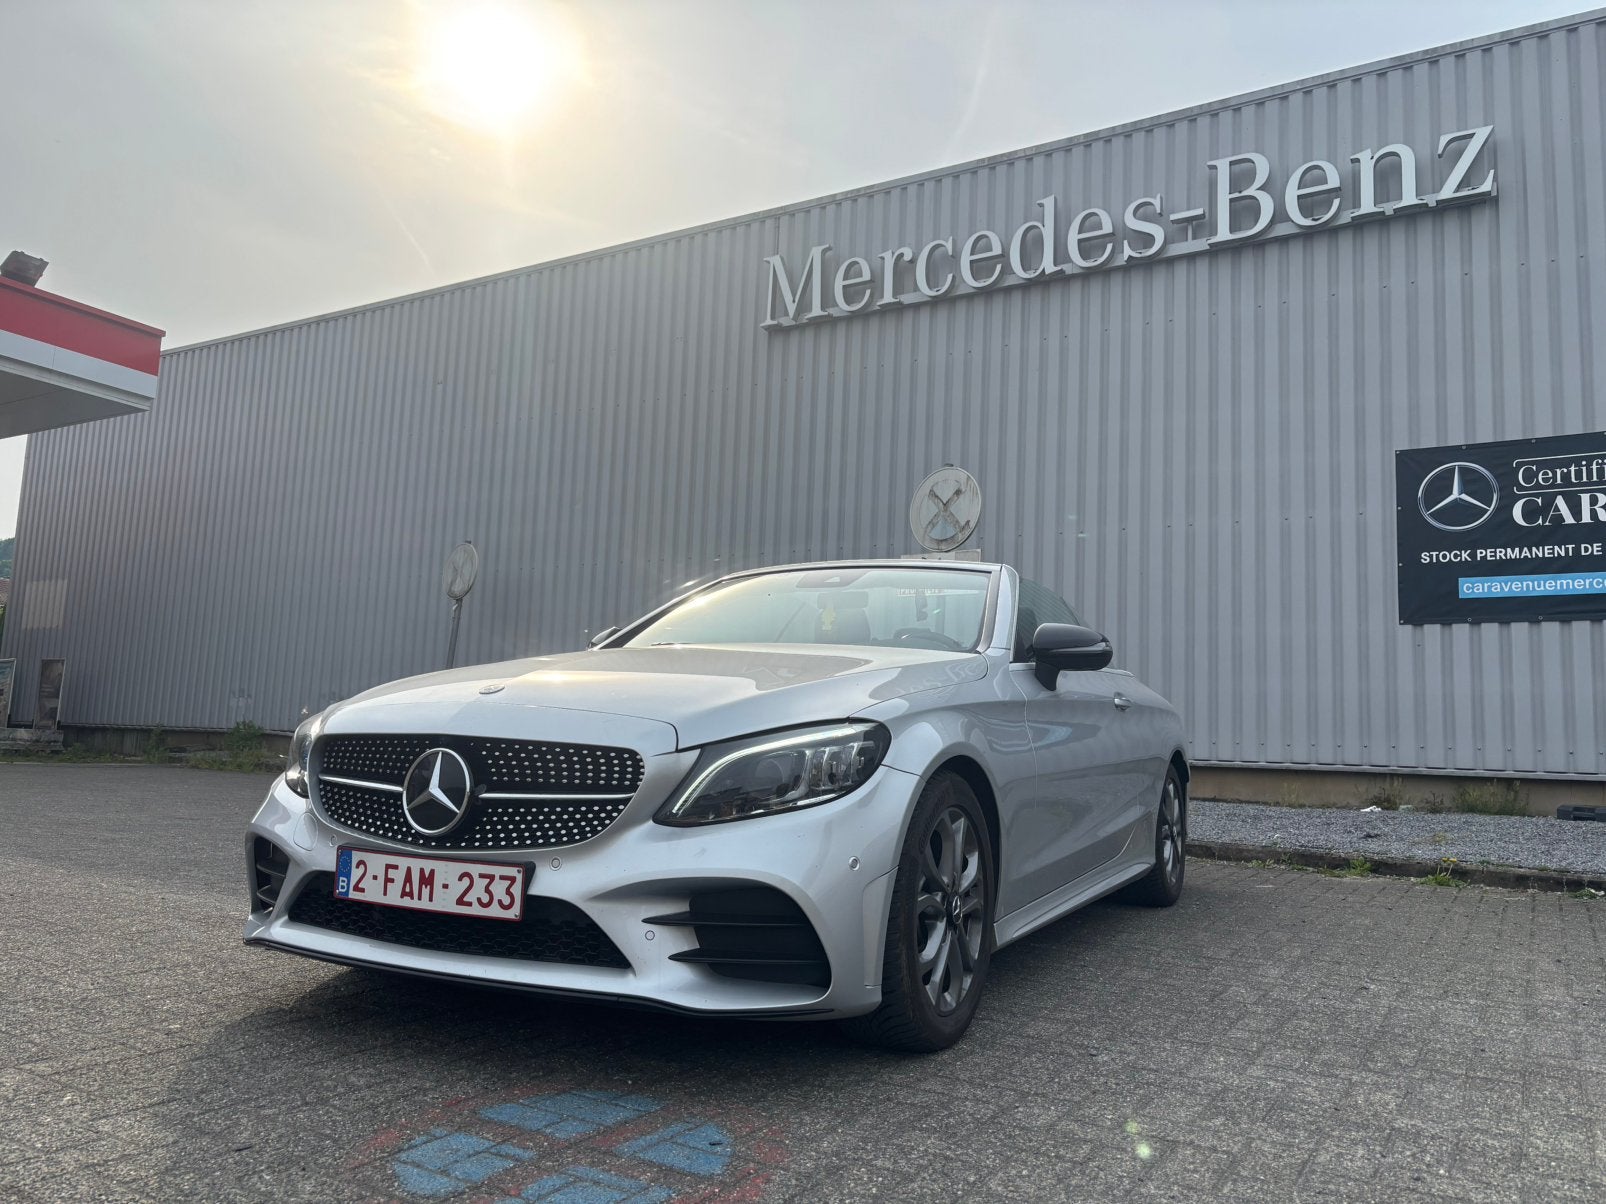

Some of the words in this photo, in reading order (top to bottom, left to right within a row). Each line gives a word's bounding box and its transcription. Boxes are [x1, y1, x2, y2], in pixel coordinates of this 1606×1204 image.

[761, 125, 1495, 327] Mercedes-Benz
[1512, 492, 1606, 527] CAR
[1420, 550, 1471, 564] STOCK
[1477, 545, 1575, 561] PERMANENT
[1581, 542, 1603, 556] DE
[1463, 576, 1606, 594] caravenuemerc
[338, 876, 347, 892] B
[352, 859, 517, 910] 2-FAM-233
